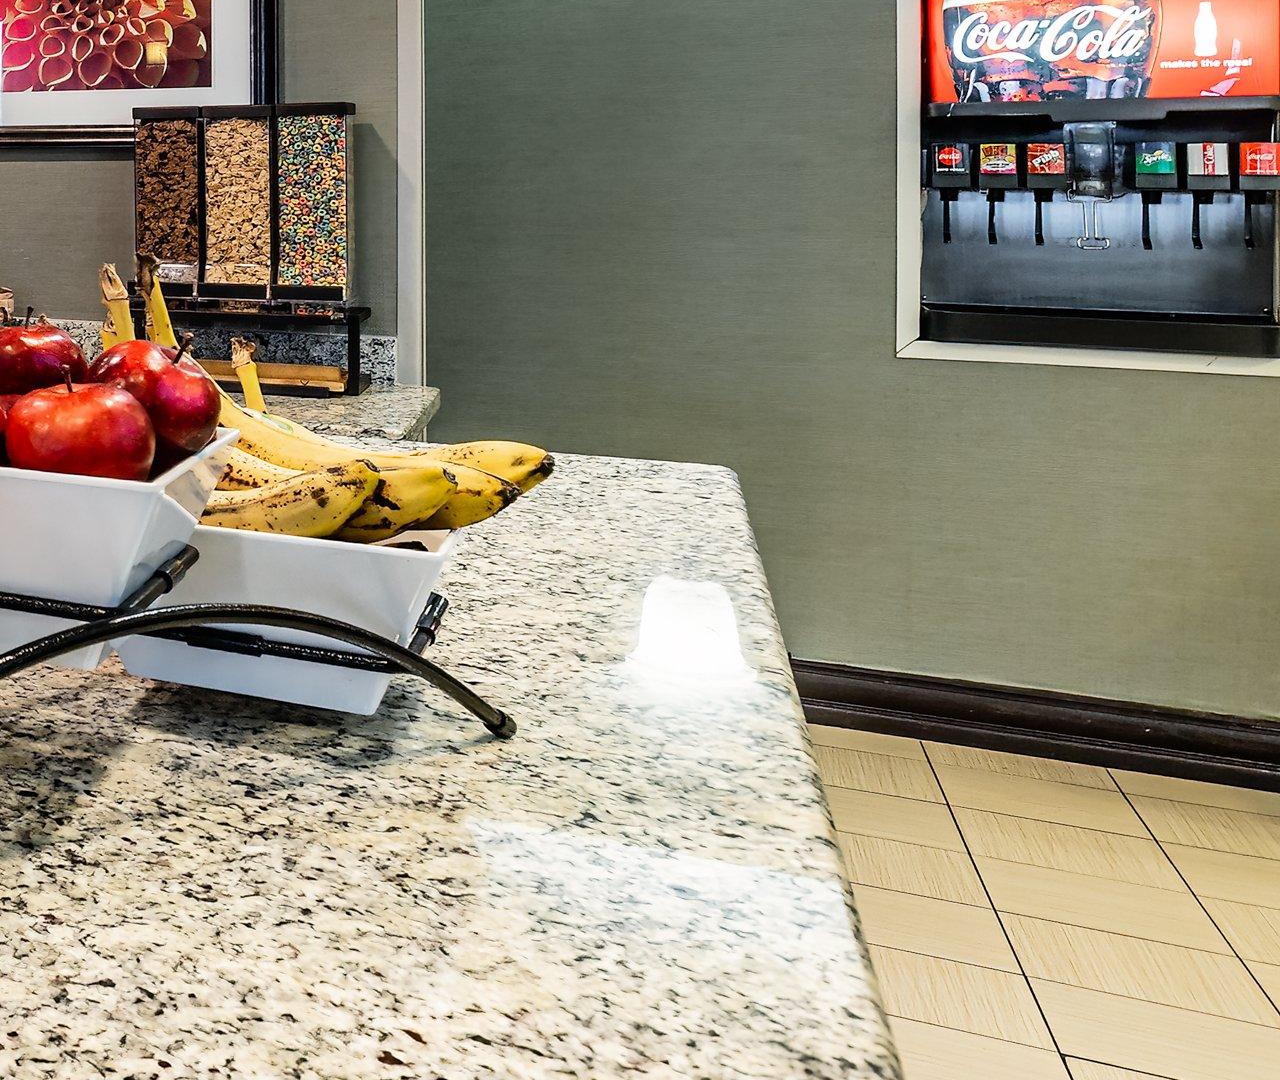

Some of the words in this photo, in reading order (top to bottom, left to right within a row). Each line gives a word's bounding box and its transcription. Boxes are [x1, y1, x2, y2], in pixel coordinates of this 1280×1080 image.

[953, 4, 1151, 63] Coca-Cola
[1159, 59, 1198, 69] makes
[1200, 58, 1221, 67] the
[1140, 150, 1172, 166] Sprite
